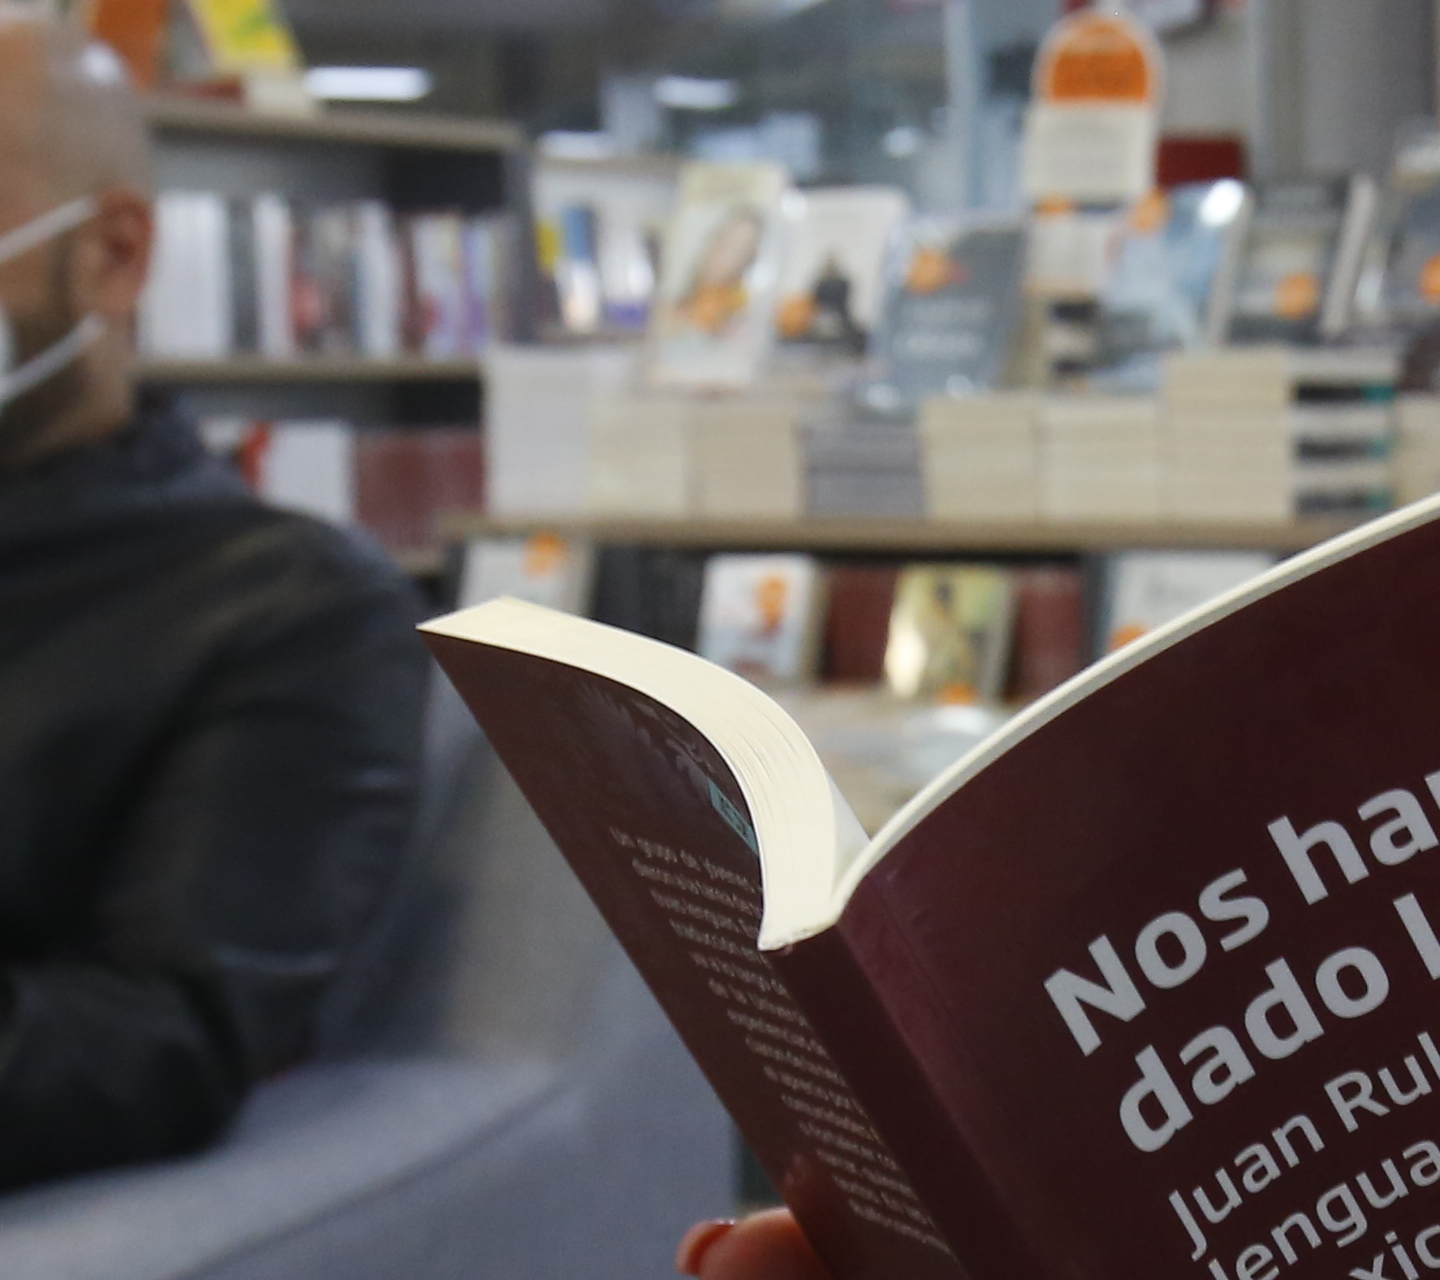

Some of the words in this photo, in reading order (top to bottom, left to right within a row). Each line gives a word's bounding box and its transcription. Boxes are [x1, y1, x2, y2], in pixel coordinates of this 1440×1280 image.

[1044, 868, 1269, 1056] Nos
[1120, 944, 1391, 1152] dado
[1169, 1115, 1324, 1261] Juan
